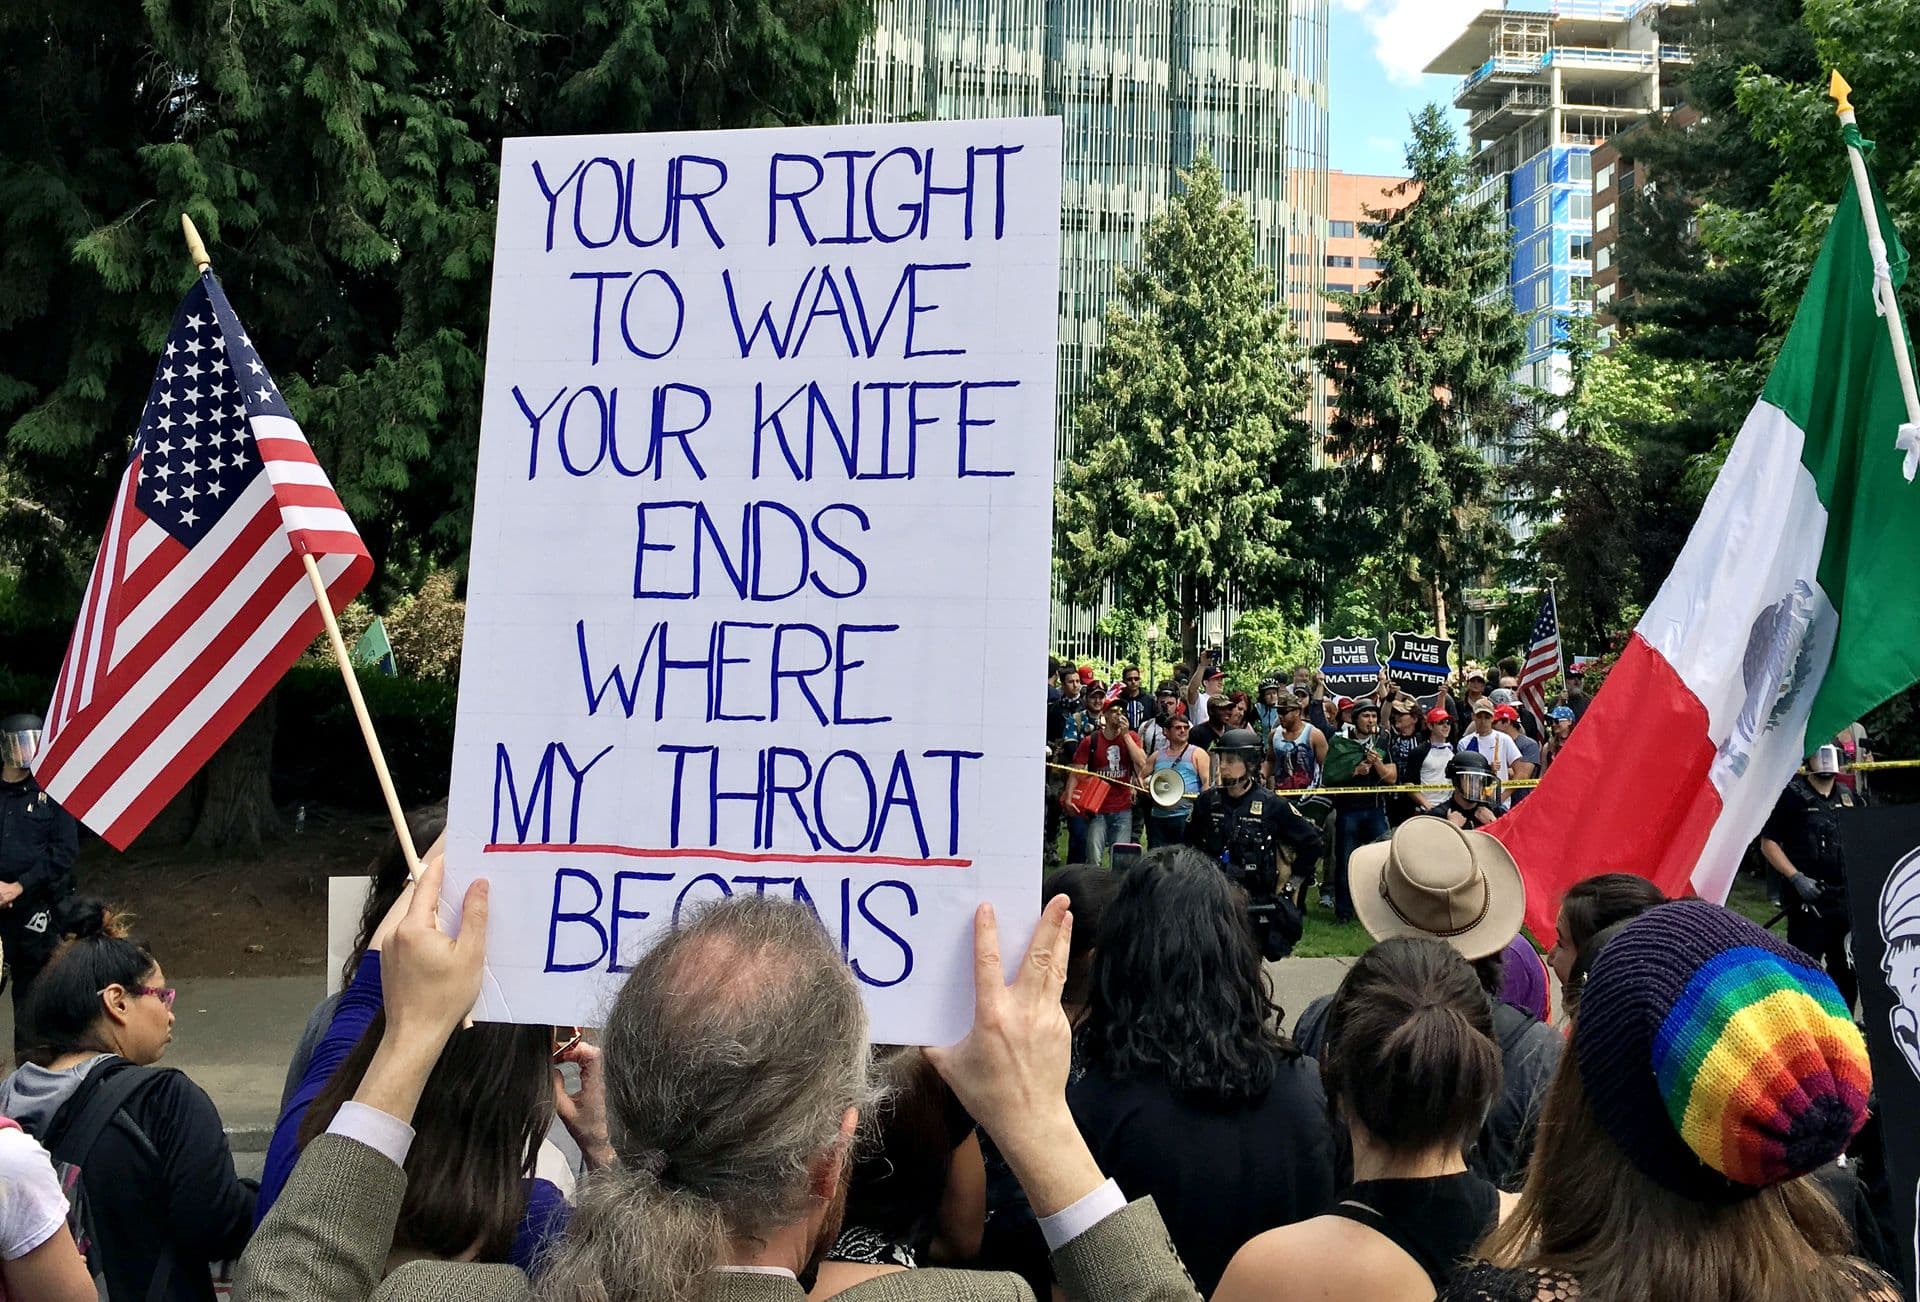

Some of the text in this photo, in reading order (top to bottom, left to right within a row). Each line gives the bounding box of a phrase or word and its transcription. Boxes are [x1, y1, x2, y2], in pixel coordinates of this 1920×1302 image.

[532, 146, 1023, 251] YOUR RIGHT
[571, 263, 969, 365] TO WAVE
[512, 381, 1019, 480] YOUR KNIFE
[633, 501, 869, 601] ENDS
[577, 621, 898, 726] WHERE
[1325, 674, 1378, 683] MATTER
[1332, 655, 1369, 664] LIVES
[1333, 645, 1366, 654] BLUE
[1390, 669, 1445, 684] MATTER
[1401, 650, 1439, 664] LIVES
[1404, 641, 1439, 654] BLUE
[491, 743, 983, 858] MY THROAT
[544, 868, 919, 987] BENS
